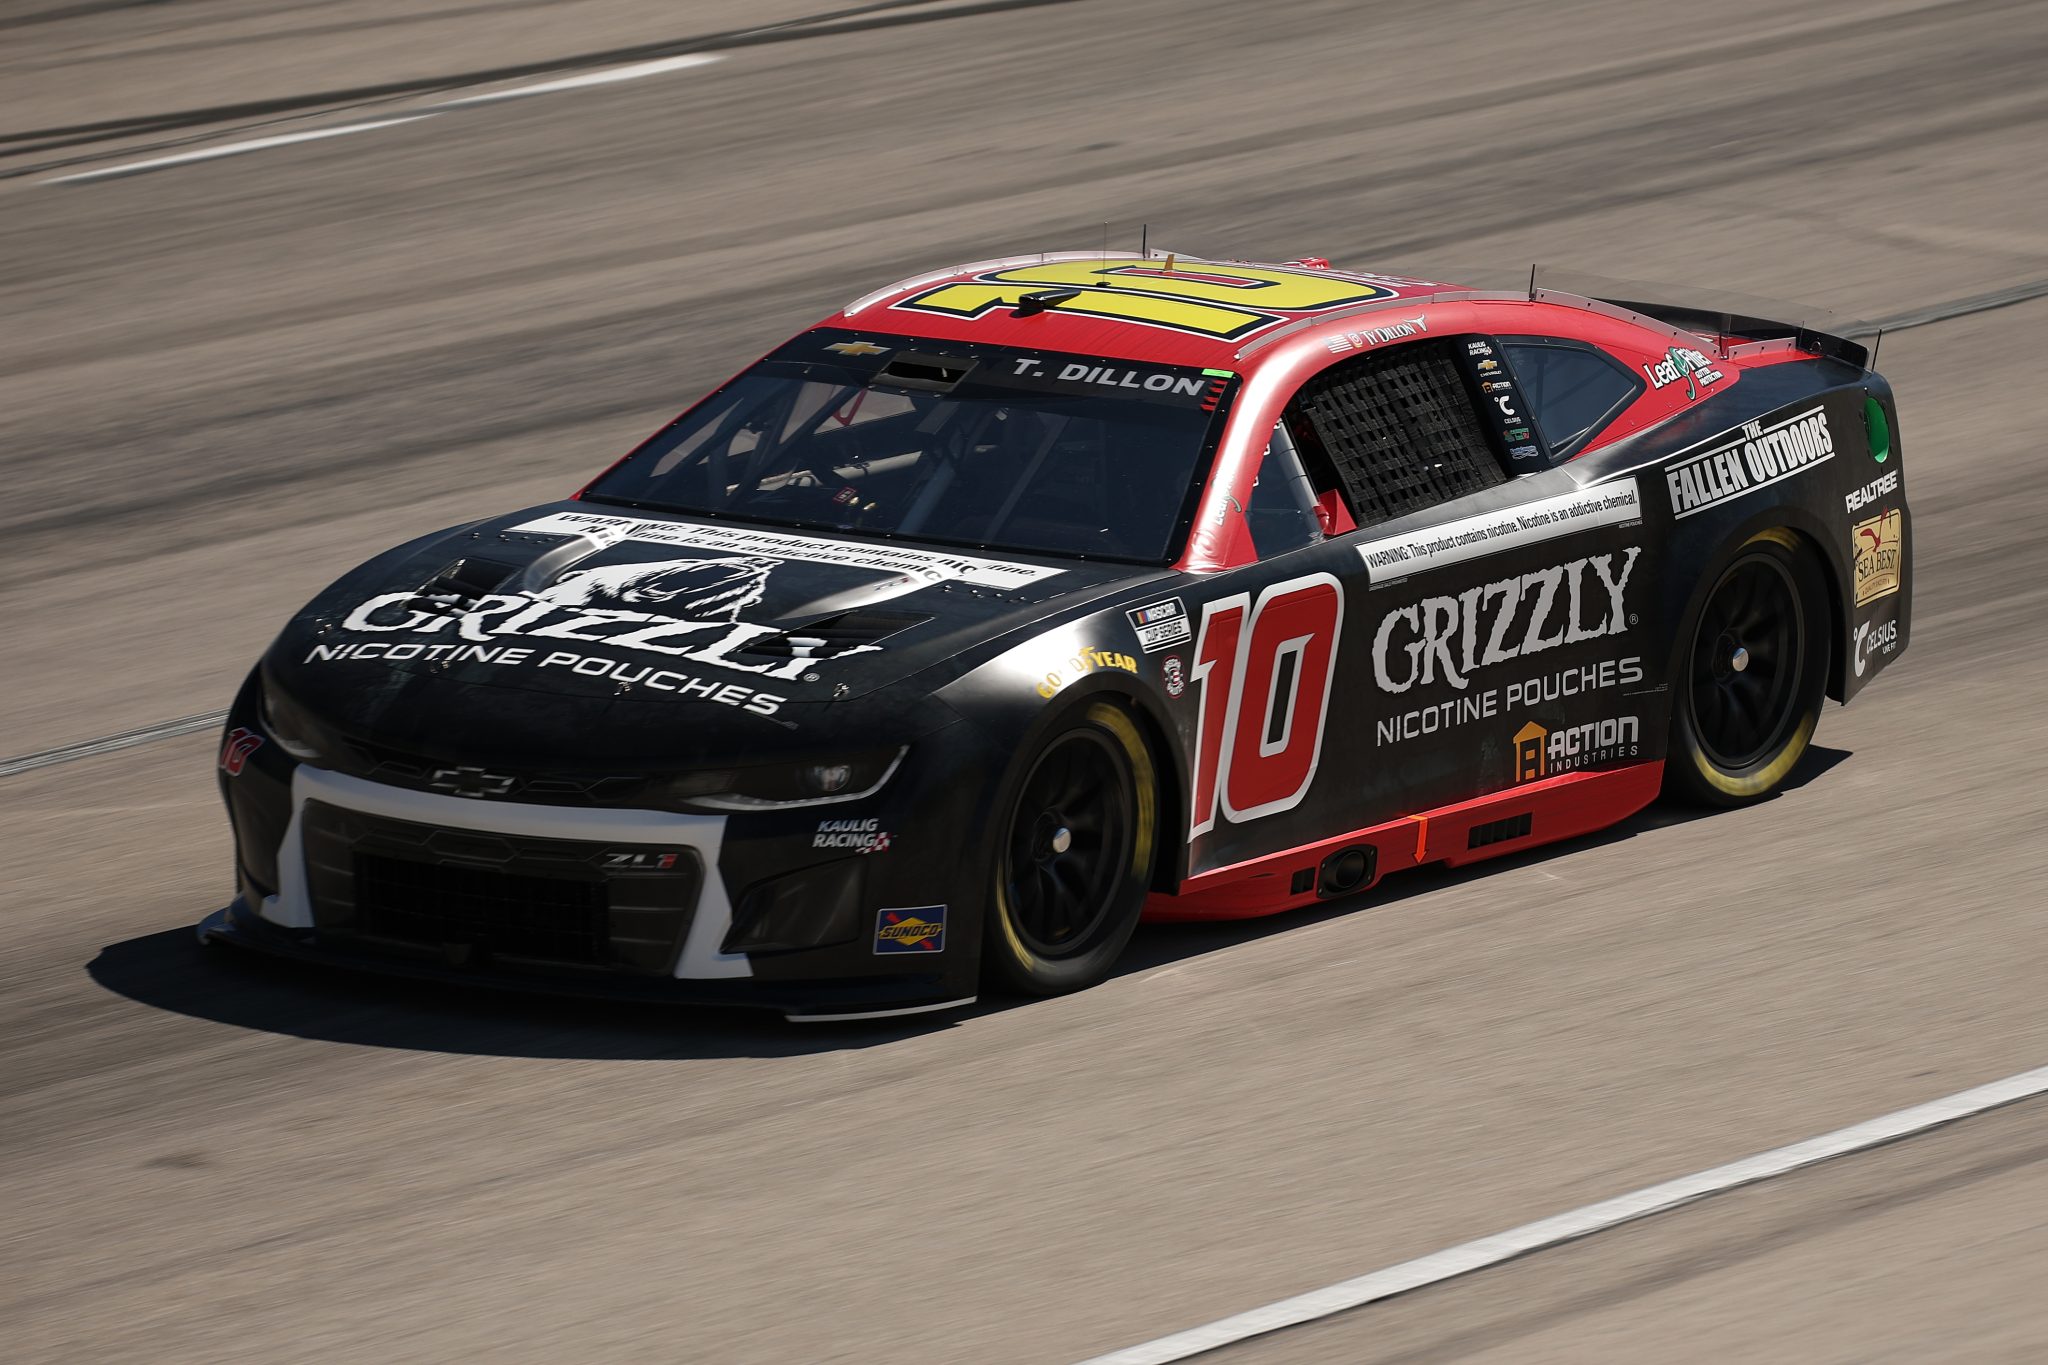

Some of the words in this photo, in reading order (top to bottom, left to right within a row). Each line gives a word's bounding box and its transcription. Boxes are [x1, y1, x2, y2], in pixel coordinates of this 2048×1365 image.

[887, 257, 1400, 344] 10
[1374, 323, 1416, 342] DILLON
[1013, 358, 1045, 377] T.
[1057, 364, 1205, 396] DILLON
[1742, 420, 1764, 441] THE
[1666, 448, 1749, 516] FALLEN
[1744, 412, 1833, 483] OUTDOORS
[1845, 469, 1898, 514] REALTREE
[1365, 546, 1411, 569] WARNING:
[1407, 542, 1427, 558] This
[1426, 537, 1457, 557] product
[1456, 528, 1488, 546] contains
[1486, 521, 1520, 538] nicotine.
[1516, 509, 1550, 530] Nicotine
[1548, 509, 1559, 522] is
[1558, 510, 1569, 520] an
[1568, 500, 1604, 518] addictive
[1602, 490, 1637, 510] chemical.
[690, 528, 739, 538] This
[735, 534, 833, 550] product
[833, 545, 935, 562] contains
[938, 557, 1036, 575] nictine.
[706, 540, 740, 548] an
[741, 545, 851, 562] addictive
[1859, 555, 1875, 582] SEA
[1876, 549, 1896, 572] BEST
[342, 591, 884, 681] GRIZZLY
[1159, 621, 1182, 638] SERIES
[1371, 546, 1642, 694] GRIZZLY
[1866, 619, 1897, 655] CELSIUS
[302, 643, 536, 665] NICOTINE
[537, 651, 788, 716] POUCHES
[1036, 646, 1138, 699] GODYEAR
[1187, 571, 1345, 844] 10
[1377, 689, 1498, 746] NICOTINE
[1506, 656, 1643, 712] POUCHES
[1547, 715, 1639, 760] ACTION
[1550, 745, 1638, 774] INDUSTRIES
[812, 833, 878, 848] RACING
[816, 818, 879, 832] KAULIG
[600, 853, 679, 869] ZL1
[881, 924, 940, 938] SUNOCO
